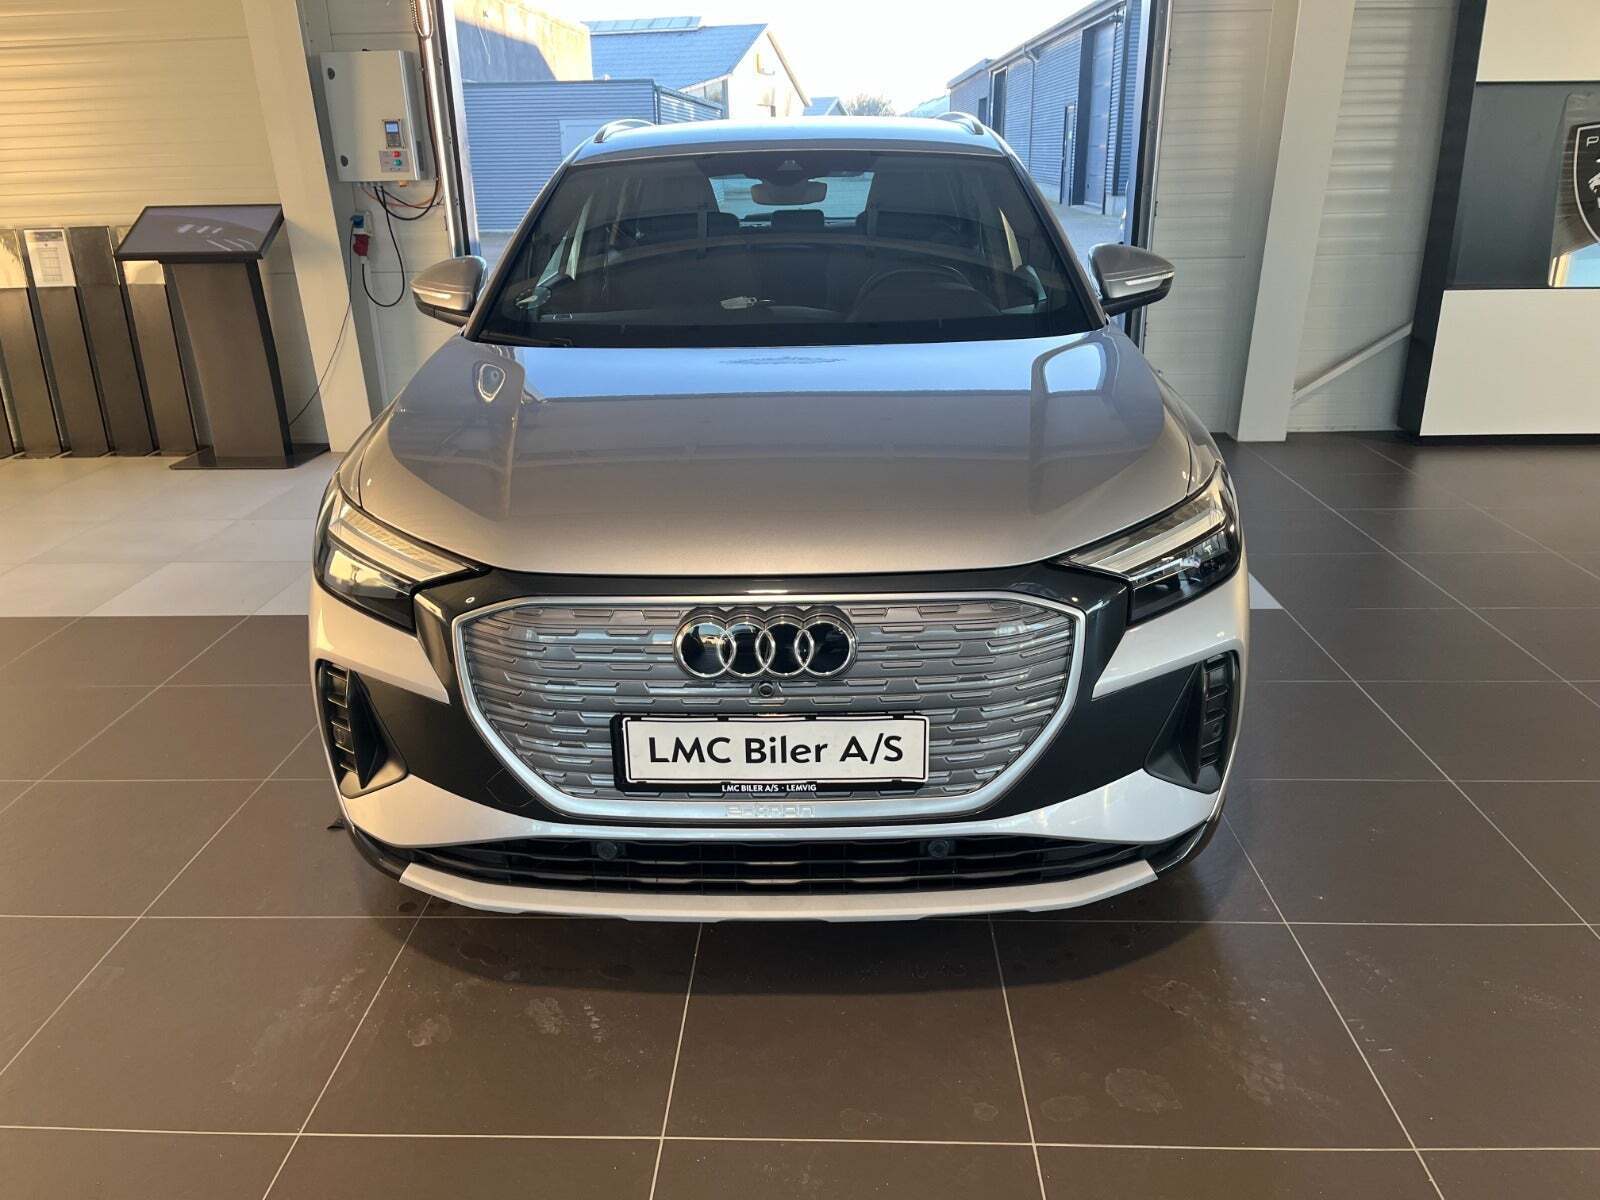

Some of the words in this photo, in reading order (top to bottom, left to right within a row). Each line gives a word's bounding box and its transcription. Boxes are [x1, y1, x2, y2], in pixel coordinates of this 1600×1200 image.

[649, 737, 732, 764] LMC
[745, 736, 829, 764] Biler
[840, 733, 904, 765] A/S
[722, 784, 740, 792] LMC
[741, 784, 763, 792] BILER
[764, 783, 779, 793] A/S
[786, 784, 817, 792] LEMVIG
